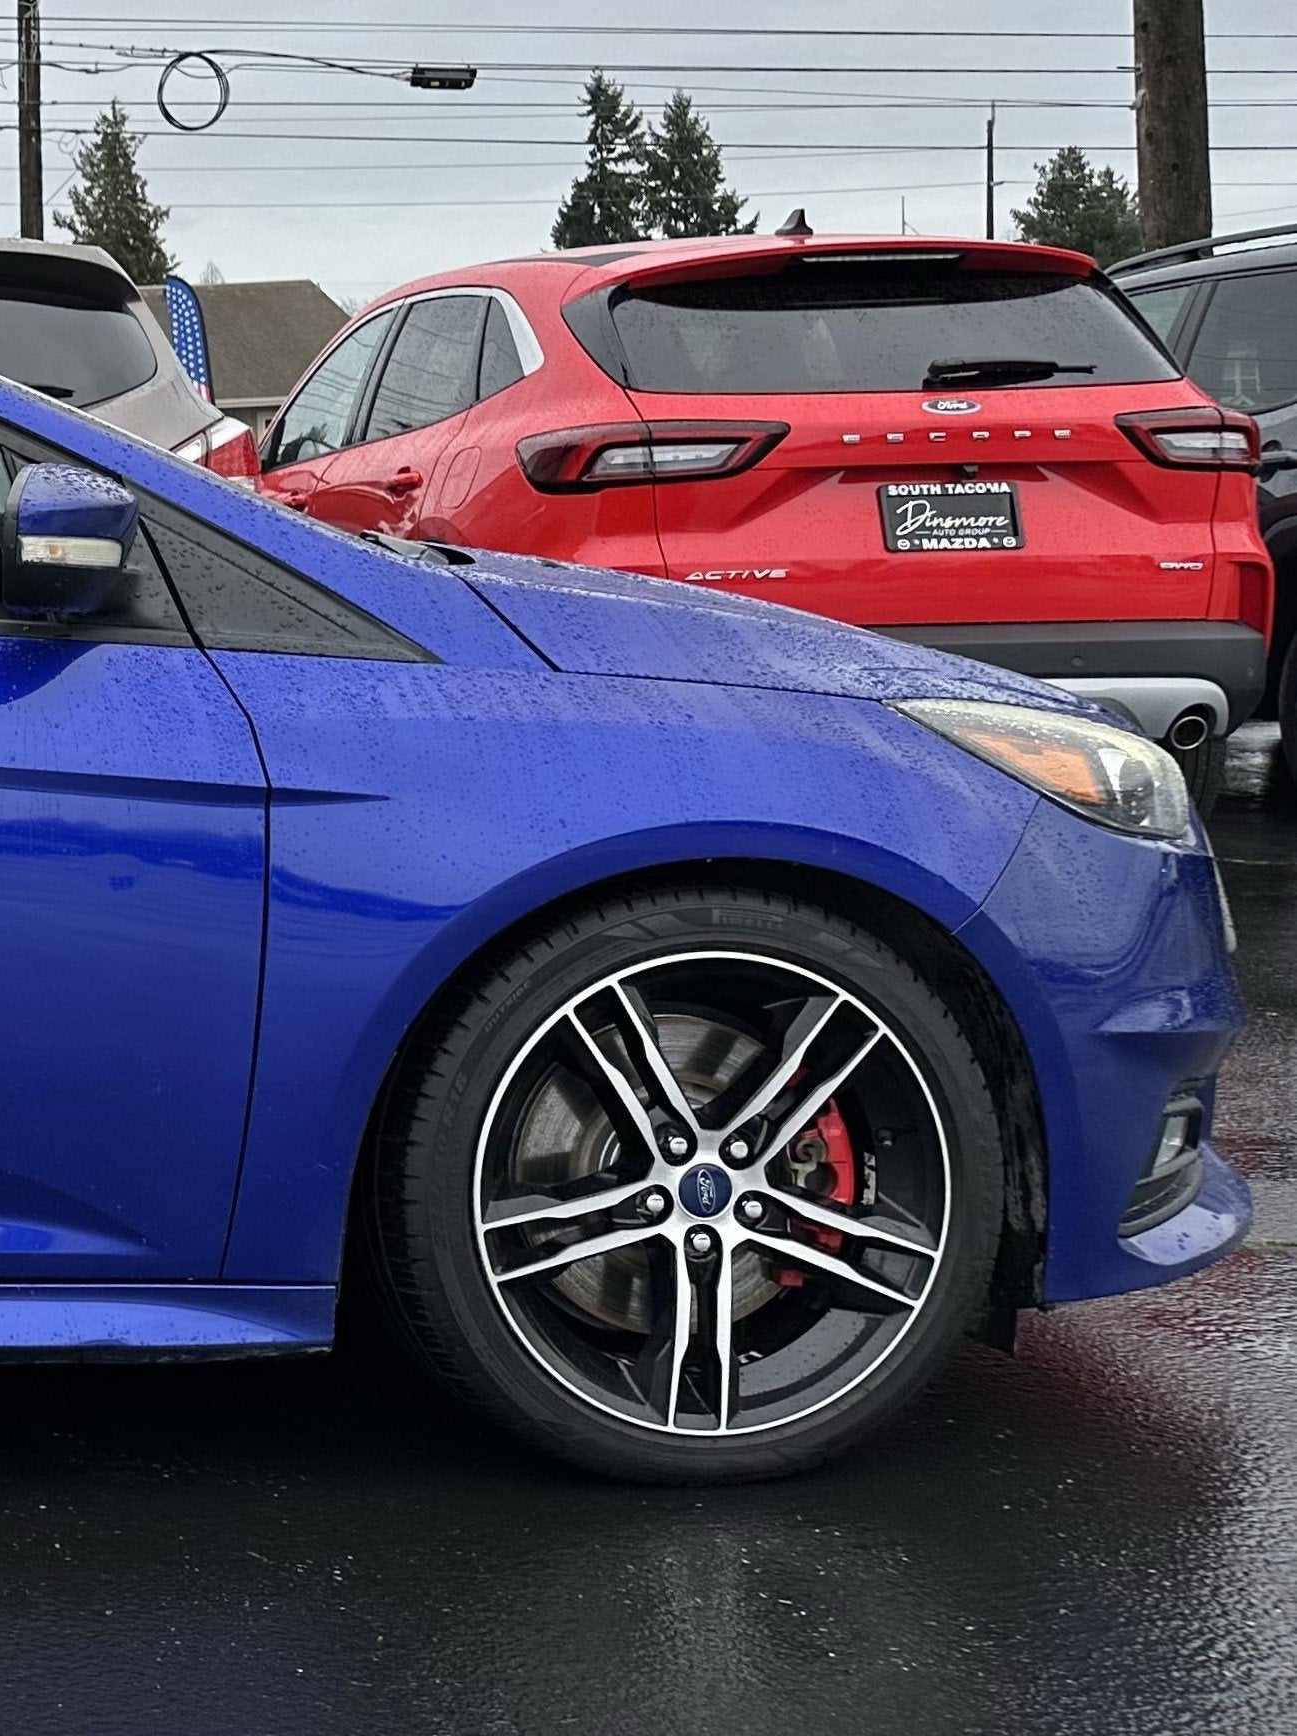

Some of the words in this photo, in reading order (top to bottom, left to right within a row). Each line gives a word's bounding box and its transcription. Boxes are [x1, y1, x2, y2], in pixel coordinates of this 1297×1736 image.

[841, 429, 1072, 444] ESCAPE
[888, 484, 941, 496] SOUTH
[945, 482, 1011, 495] TACOMA
[895, 500, 1010, 536] Dinsmore
[932, 529, 956, 537] AUTO
[958, 527, 992, 536] GROUP
[921, 537, 992, 550] MAZDA
[684, 568, 790, 581] ACTIVE
